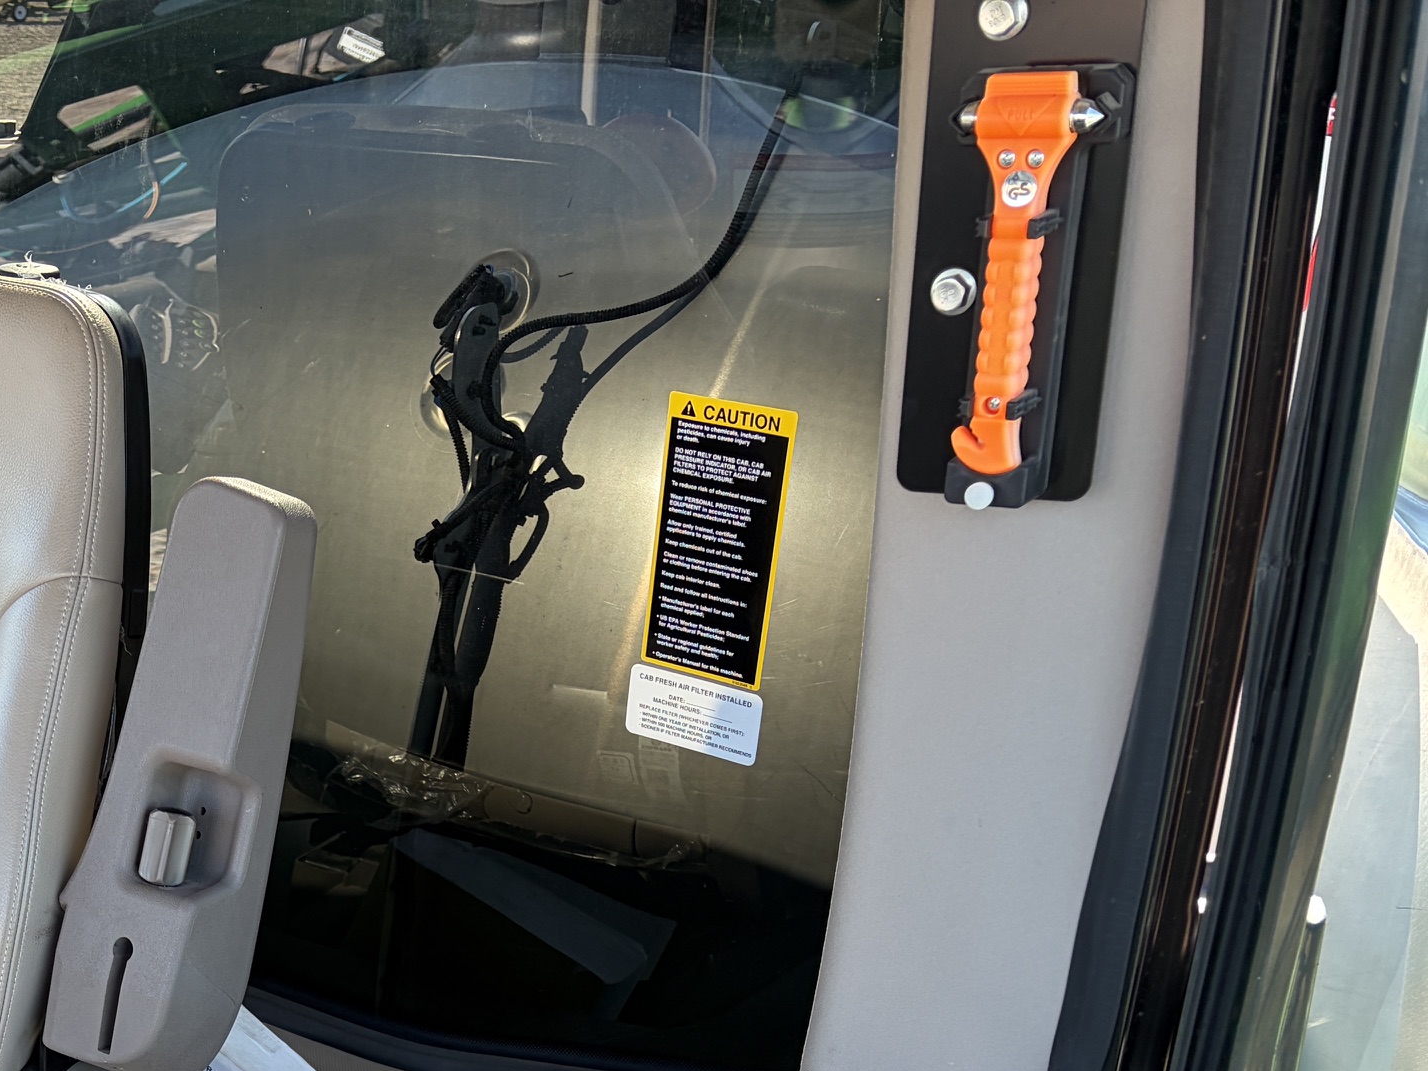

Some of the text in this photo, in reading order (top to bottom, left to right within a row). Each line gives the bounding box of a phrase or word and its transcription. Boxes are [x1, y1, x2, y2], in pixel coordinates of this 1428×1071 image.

[1007, 108, 1034, 121] PULL
[703, 405, 780, 432] CAUTION
[677, 427, 705, 437] pesticides,
[734, 437, 750, 446] injury
[678, 420, 703, 430] Exposure
[710, 426, 739, 437] chemicals,
[740, 431, 766, 442] including
[683, 435, 699, 443] death.
[673, 460, 696, 469] FILTERS
[705, 466, 732, 476] PROTECT
[732, 471, 758, 481] AGAINST
[674, 453, 704, 464] PRESSURE
[705, 459, 736, 471] INDICATOR,
[747, 467, 760, 475] CAB
[722, 455, 735, 463] THIS
[751, 461, 764, 469] CAB
[672, 466, 701, 477] CHEMICAL
[678, 482, 697, 490] reduce
[715, 489, 739, 498] chemical
[669, 499, 701, 510] EQUIPMENT
[708, 508, 739, 519] accordance
[684, 495, 714, 507] PERSONAL
[715, 502, 750, 515] PROTECTIVE
[668, 506, 691, 515] chemical
[692, 512, 731, 524] manufacturer's
[666, 526, 695, 536] applicators
[702, 534, 716, 542] apply
[667, 518, 681, 526] Allow
[715, 530, 737, 539] certified
[665, 538, 678, 546] Keep
[678, 542, 705, 552] chemicals
[661, 569, 674, 578] Keep
[685, 575, 704, 584] interior
[660, 582, 673, 590] Read
[684, 588, 700, 596] follow
[708, 593, 739, 606] instructions
[660, 603, 683, 612] chemical
[661, 595, 699, 609] Manufacturer's
[699, 604, 712, 612] label
[666, 622, 696, 634] Agricultural
[679, 619, 698, 628] Worker
[698, 624, 725, 635] Protection
[725, 630, 749, 641] Standard
[655, 651, 681, 662] Operator's
[682, 658, 700, 667] Manual
[639, 672, 752, 708] CAB FRESH AIR FILTER INSTALLED
[668, 694, 685, 703] DATE:
[652, 697, 700, 714] MACHINE HOURS:
[639, 703, 661, 713] REPLACE
[662, 709, 678, 717] FILTER
[678, 714, 708, 726] (WHICHEVER
[709, 722, 727, 731] COMES
[642, 711, 657, 719] WITHIN
